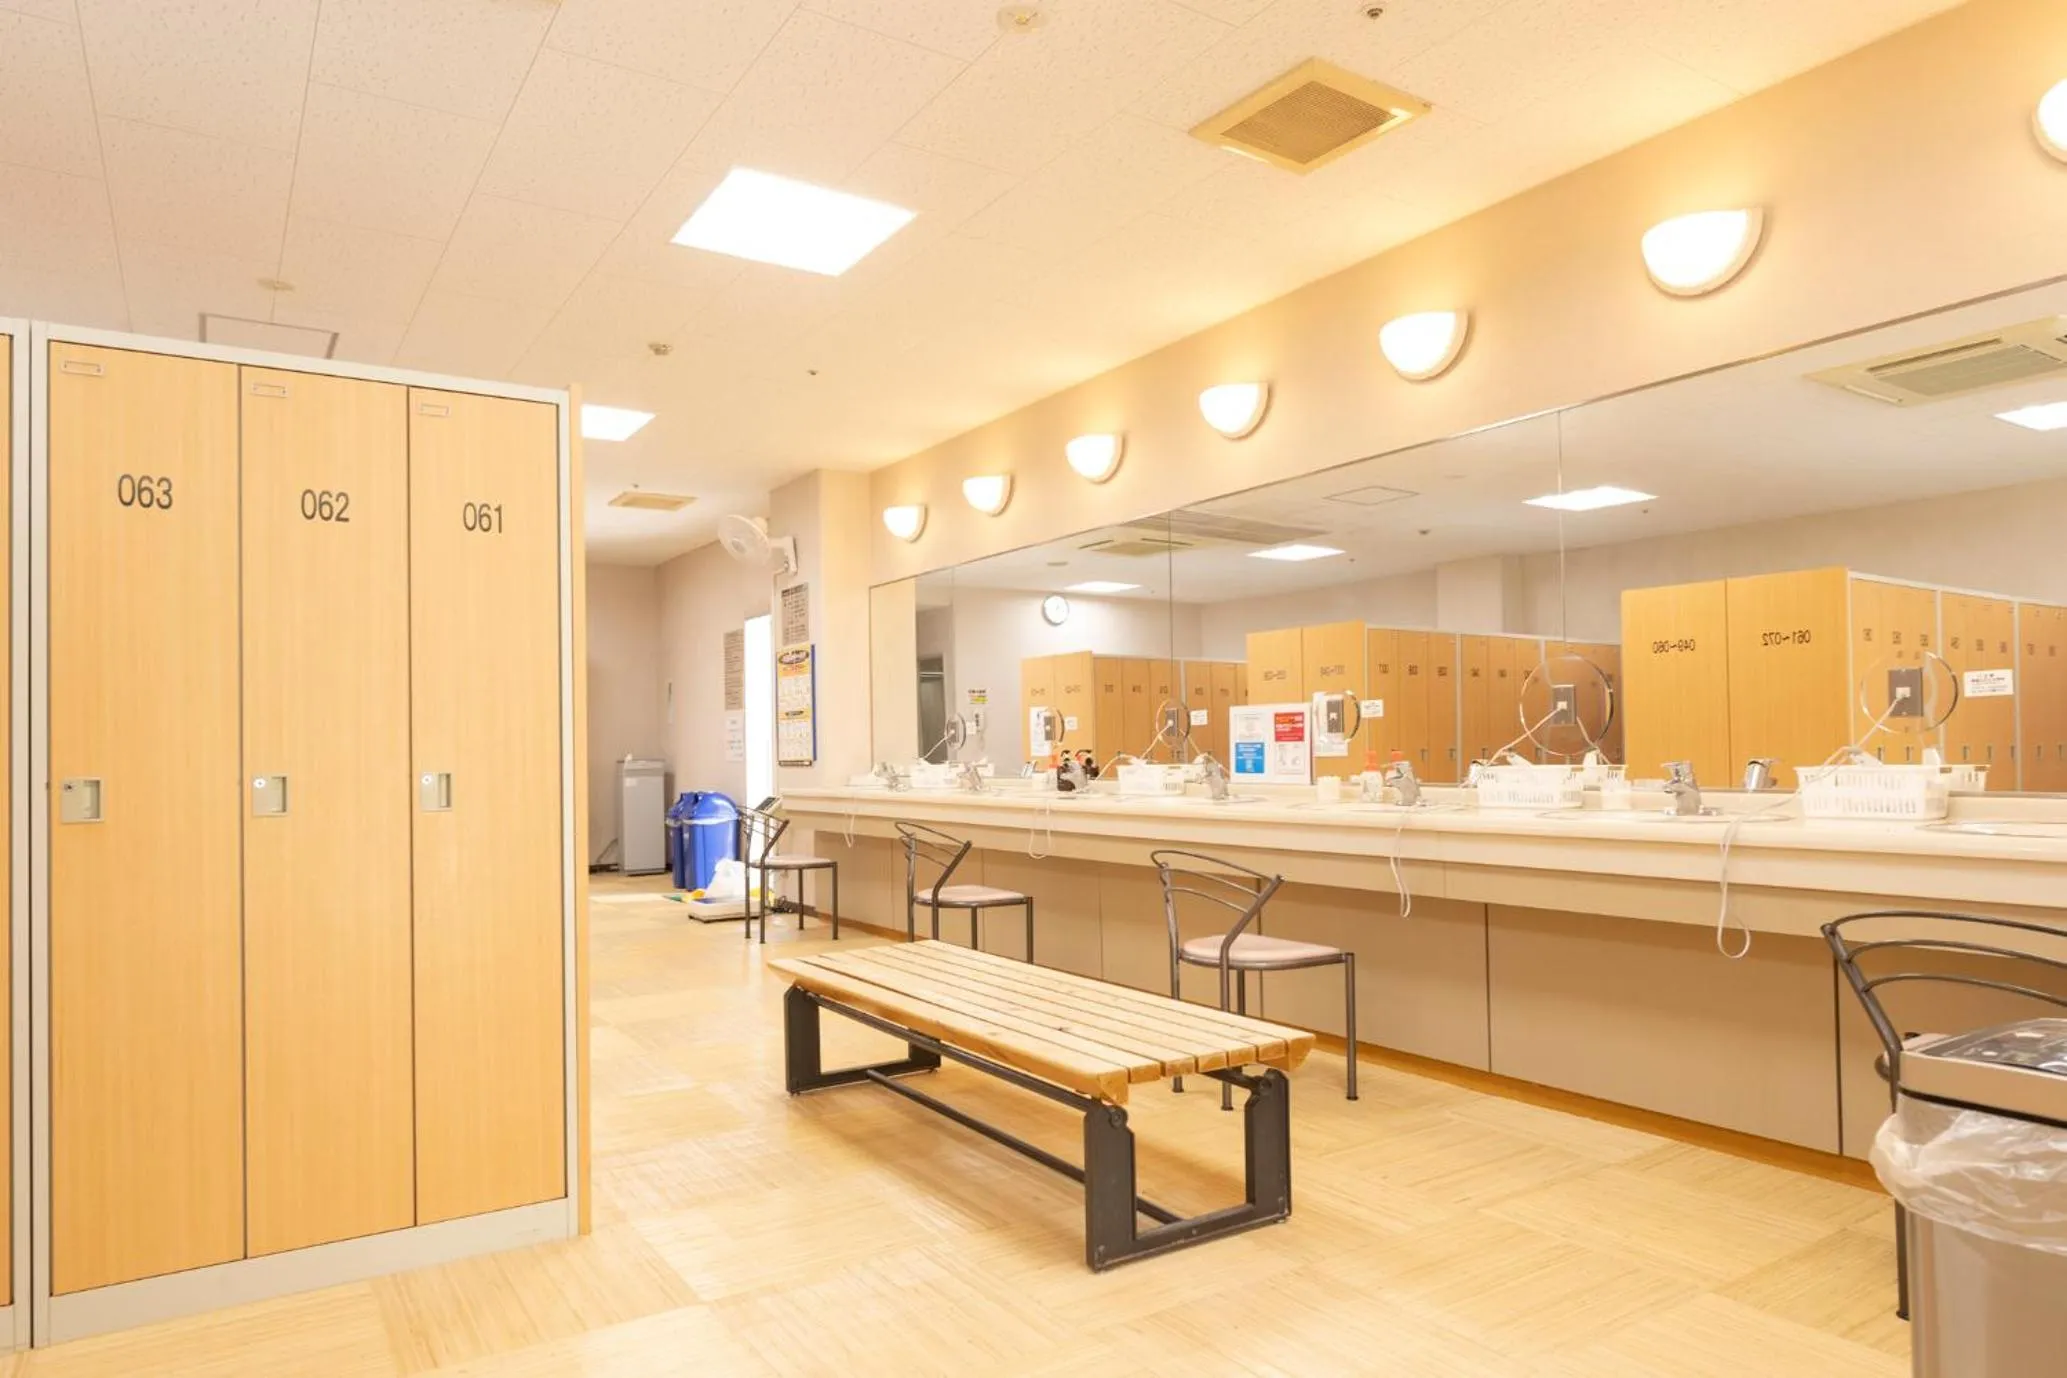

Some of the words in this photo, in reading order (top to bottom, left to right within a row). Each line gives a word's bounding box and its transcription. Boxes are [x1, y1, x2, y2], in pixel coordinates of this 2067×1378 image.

[118, 474, 173, 509] 063
[300, 489, 350, 522] 062
[463, 502, 502, 534] 061
